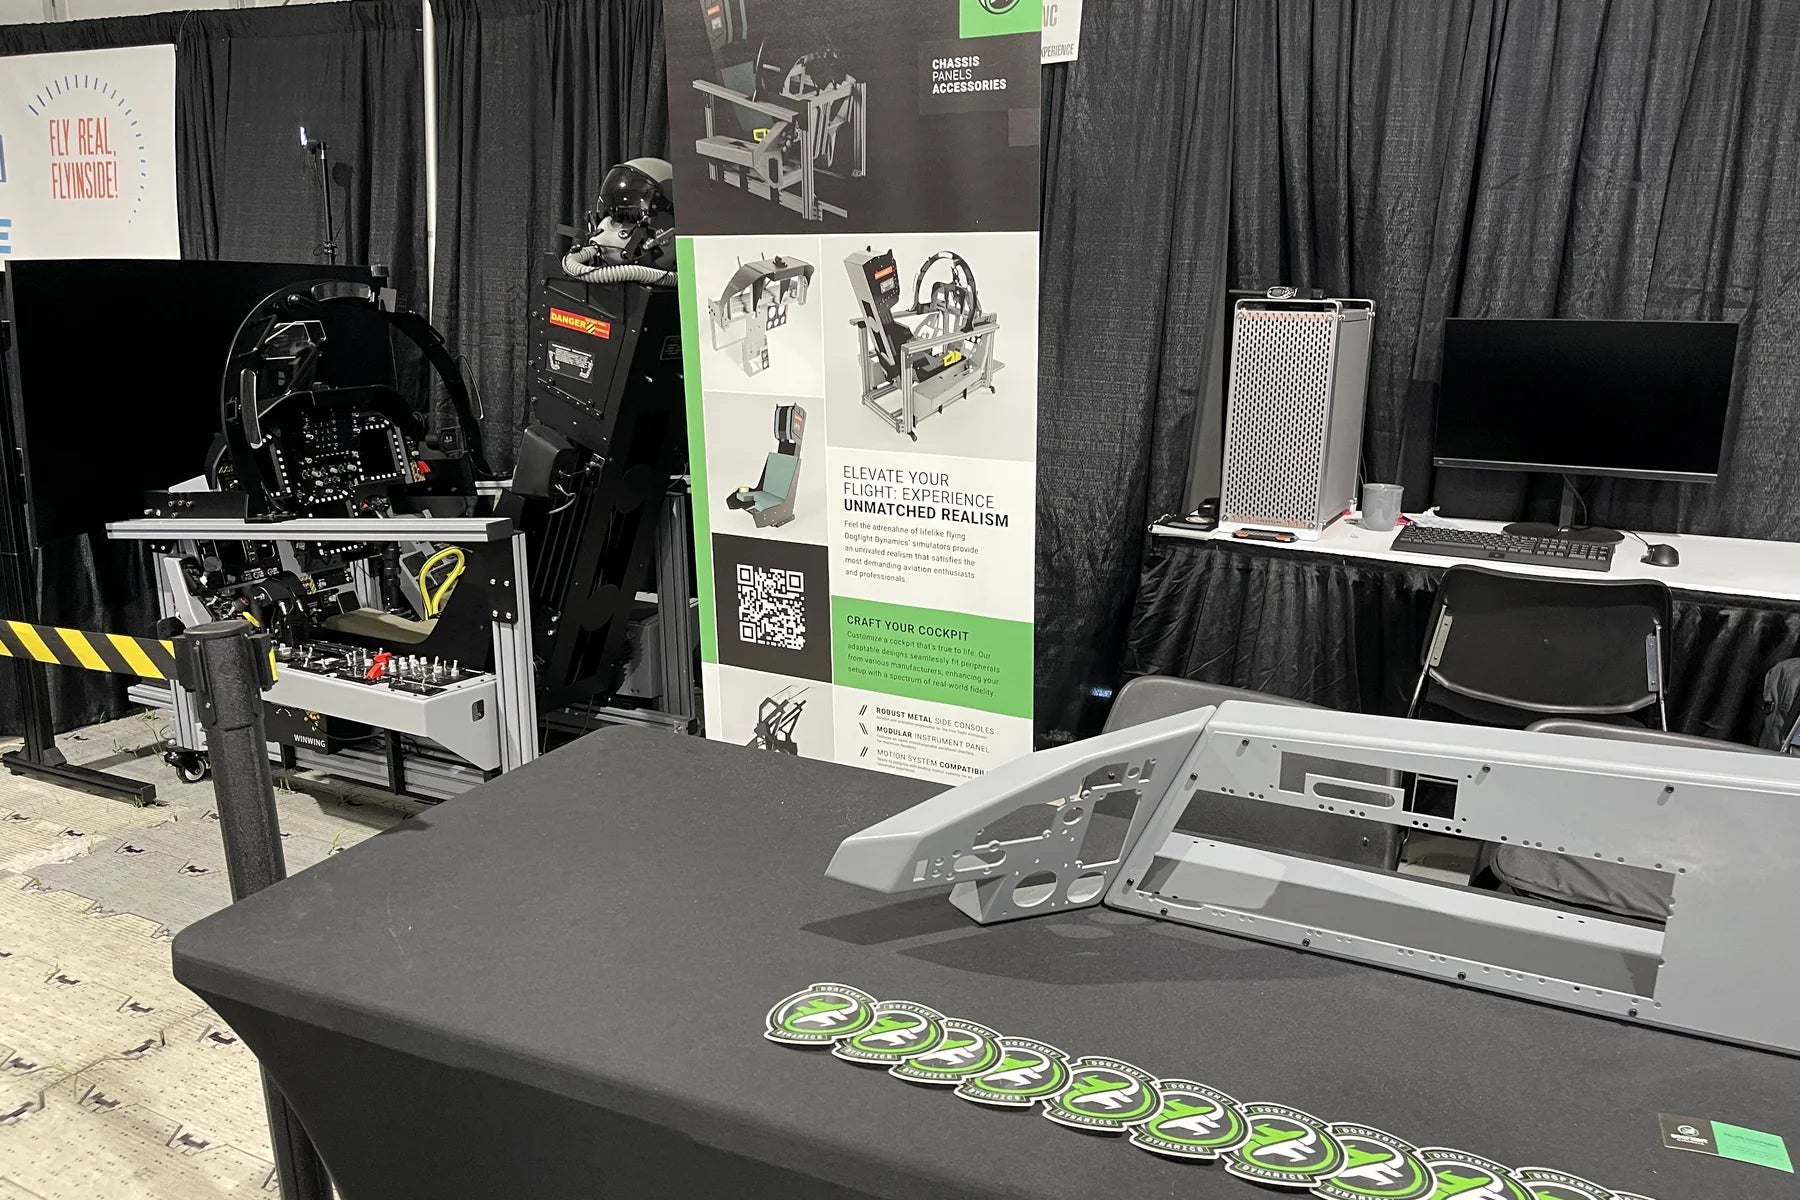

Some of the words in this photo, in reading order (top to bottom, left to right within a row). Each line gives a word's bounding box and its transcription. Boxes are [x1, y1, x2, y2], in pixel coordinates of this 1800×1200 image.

[1041, 43, 1075, 58] XPERIENCE
[932, 56, 980, 70] CHASSIS
[932, 69, 972, 82] PANELS
[932, 78, 1007, 94] ACCESSORIES
[50, 118, 70, 157] FLY
[78, 117, 117, 157] REAL,
[52, 161, 119, 199] FLYINSIDE!
[551, 312, 587, 329] DANGER
[843, 465, 904, 484] ELEVATE
[908, 471, 949, 487] YOUR
[844, 481, 897, 500] FLIGHT:
[902, 487, 995, 509] EXPERIENCE
[844, 498, 936, 519] UNMATCHED
[941, 507, 1009, 528] REALISM
[844, 519, 858, 529] Feel
[859, 522, 871, 530] the
[872, 524, 909, 534] adrenaline
[910, 527, 918, 535] of
[919, 527, 945, 538] lifelike
[946, 530, 966, 542] flying
[844, 532, 873, 543] Dogfight
[912, 540, 951, 551] simulators
[952, 545, 979, 555] provide
[854, 546, 886, 556] unrivaled
[886, 550, 913, 559] realism
[914, 552, 929, 561] that
[931, 555, 962, 565] satisfies
[963, 558, 976, 567] the
[844, 557, 862, 565] most
[863, 558, 902, 571] demanding
[903, 563, 932, 573] aviation
[933, 567, 975, 579] enthusiasts
[845, 569, 858, 577] and
[846, 614, 882, 628] CRAFT
[884, 620, 915, 634] YOUR
[918, 625, 969, 641] COCKPIT
[847, 630, 882, 643] Customize
[889, 638, 915, 648] cockpit
[938, 644, 953, 653] true
[978, 650, 991, 660] Our
[847, 643, 880, 654] adaptable
[881, 648, 908, 659] designs
[910, 653, 950, 666] seamlessly
[951, 658, 959, 666] fit
[960, 660, 1001, 674] peripherals
[847, 653, 863, 662] from
[864, 657, 890, 667] various
[945, 670, 982, 684] enhancing
[983, 677, 999, 686] your
[847, 666, 867, 675] setup
[868, 670, 882, 678] with
[889, 673, 922, 684] spectrum
[876, 707, 906, 718] ROBUST
[907, 712, 933, 724] METAL
[934, 717, 952, 727] SIDE
[953, 720, 995, 735] CONSOLES
[293, 733, 326, 748] WINWING
[876, 725, 913, 738] MODULAR
[914, 732, 964, 748] INSTRUMENT
[965, 741, 991, 754] PANEL
[876, 748, 906, 761] MOTION
[907, 754, 938, 767] SYSTEM
[1091, 1059, 1145, 1080] DOGFIGHT
[1170, 1082, 1228, 1103] DOGFIGHT
[1257, 1106, 1318, 1128] DOGFIGHT
[1342, 1127, 1405, 1149] DOGFIGHT
[1432, 1151, 1500, 1171] DOGFIGHT
[1532, 1171, 1603, 1194] DOGFIGHT
